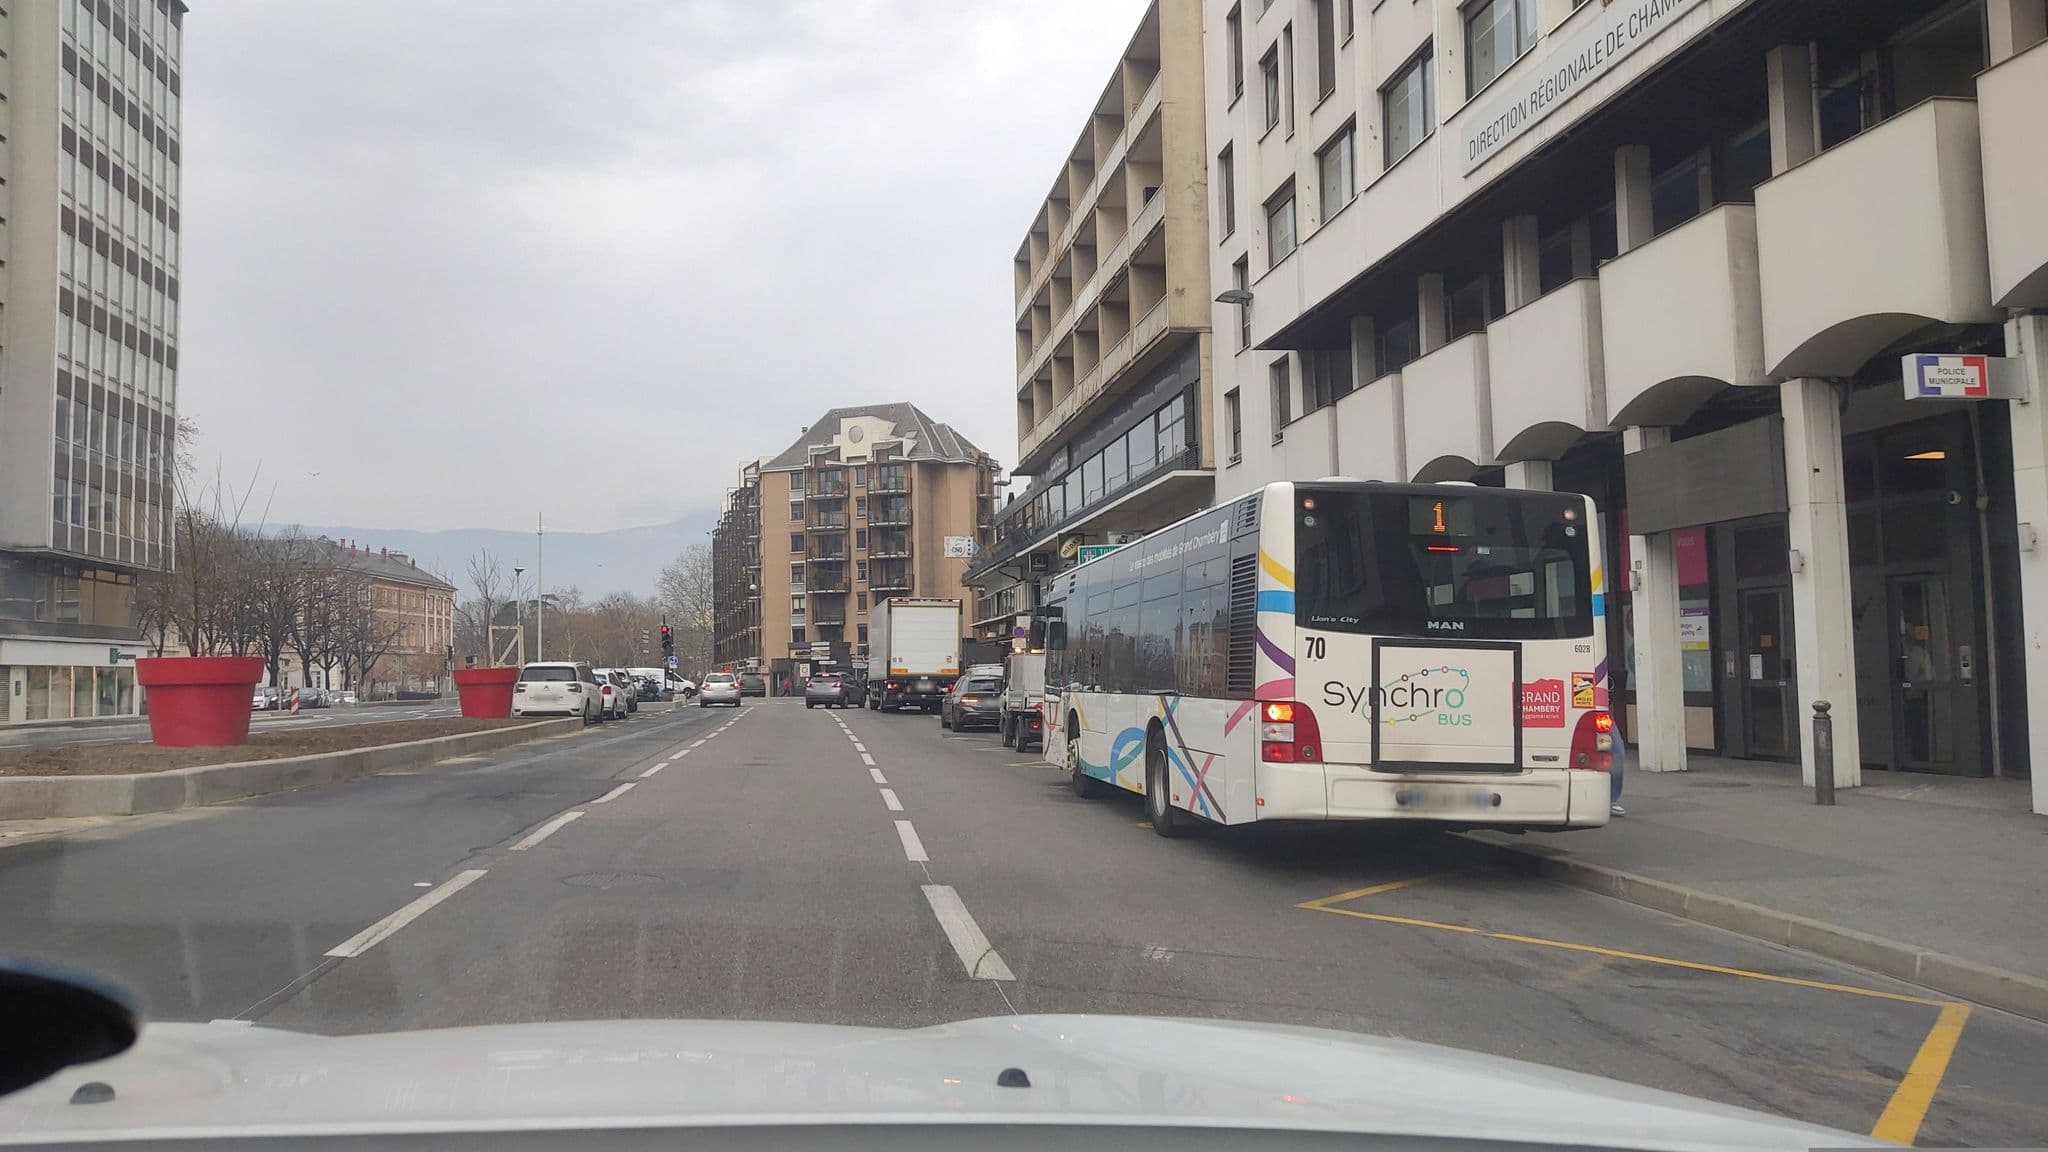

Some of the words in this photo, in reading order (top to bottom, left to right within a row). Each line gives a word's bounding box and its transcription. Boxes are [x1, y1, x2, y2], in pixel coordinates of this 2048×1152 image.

[1469, 99, 1527, 161] DIRECTION
[1530, 40, 1603, 115] RÉGIONALE
[1606, 23, 1625, 57] DE
[1928, 377, 1977, 385] MUNICIPALE
[1433, 502, 1446, 532] 1
[1311, 615, 1337, 623] Lion's
[1340, 616, 1360, 624] City
[1427, 621, 1465, 630] MAN
[1305, 636, 1326, 660] 70
[1574, 644, 1591, 653] 6028
[1323, 681, 1464, 713] Synchro
[1438, 713, 1472, 726] BUS
